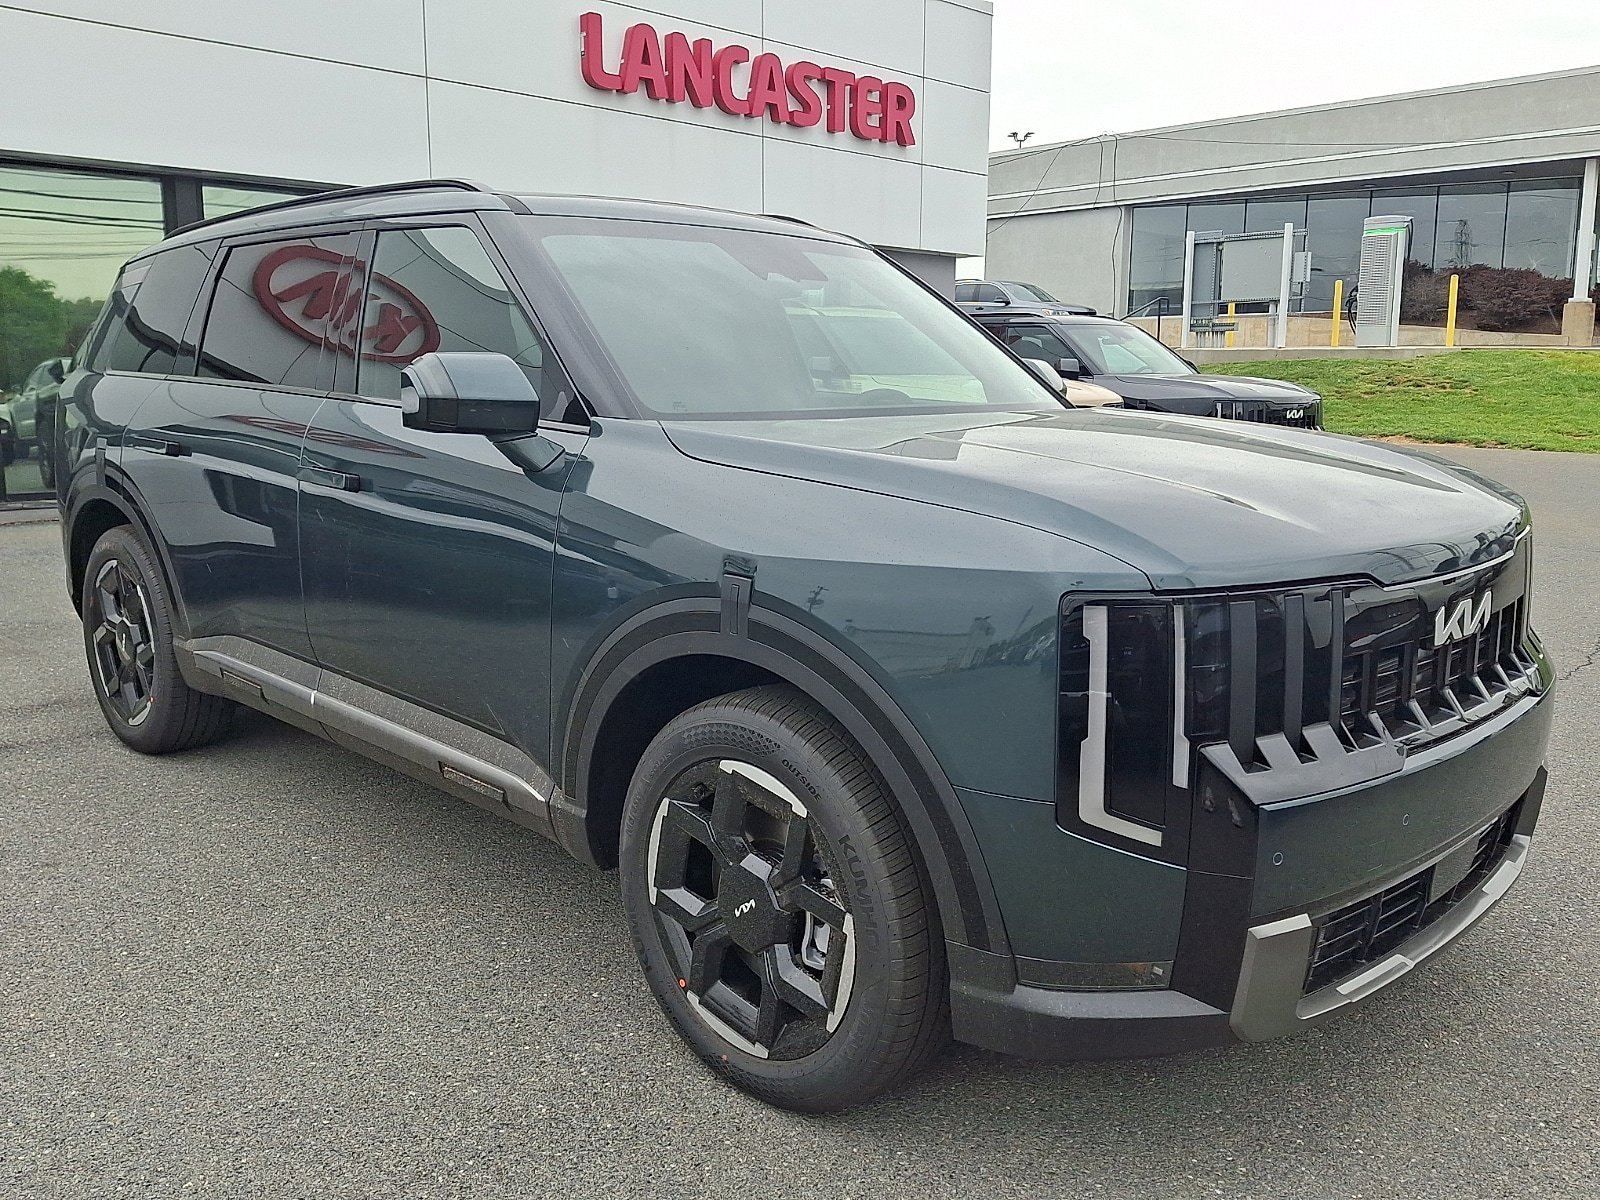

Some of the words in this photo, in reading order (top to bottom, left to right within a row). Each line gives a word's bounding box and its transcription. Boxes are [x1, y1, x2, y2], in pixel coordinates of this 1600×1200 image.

[579, 11, 916, 146] LANCASTER
[1286, 409, 1304, 419] KIA
[1434, 590, 1492, 646] KIA
[781, 758, 823, 803] OUTSIDE
